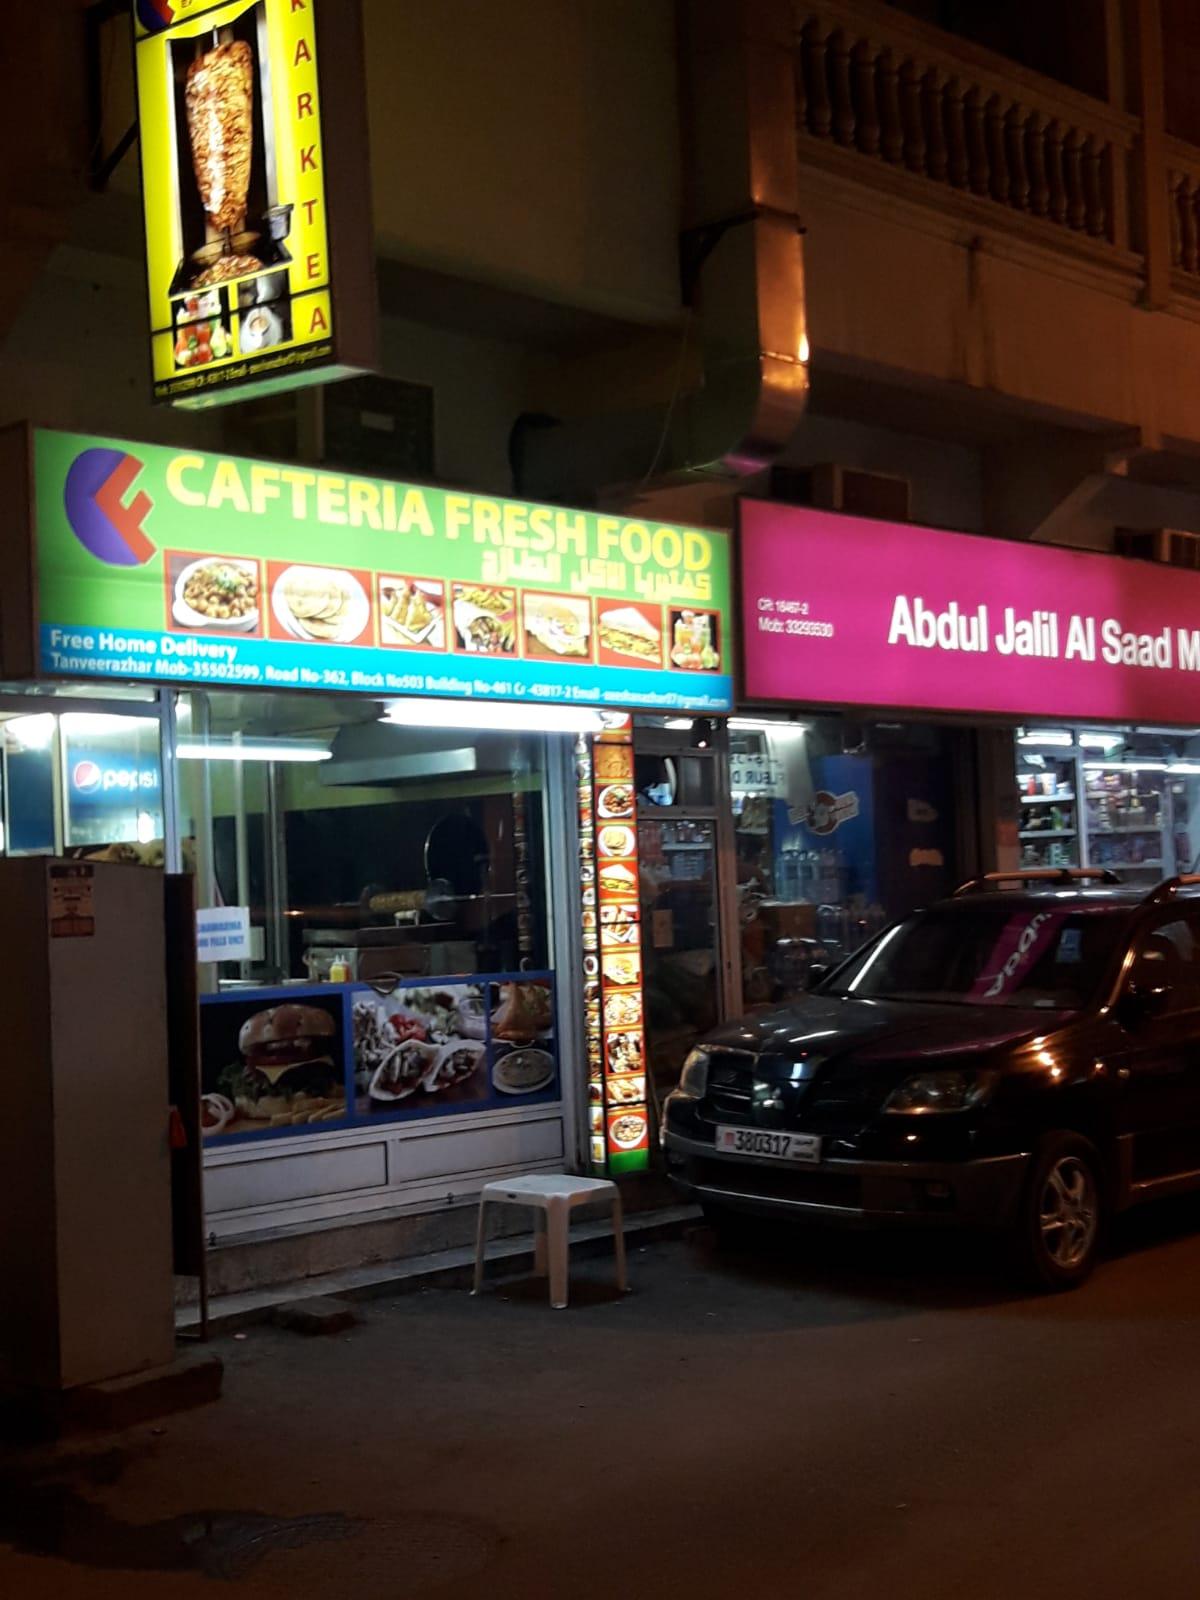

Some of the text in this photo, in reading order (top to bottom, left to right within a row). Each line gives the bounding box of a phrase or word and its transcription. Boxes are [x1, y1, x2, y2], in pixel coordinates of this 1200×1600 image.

[166, 455, 712, 572] CAFTERIA FRESH FOOD
[50, 629, 238, 664] Free Home Delivery
[887, 594, 987, 652] Abdul
[995, 606, 1058, 659] Jalil
[1065, 614, 1096, 662] Al
[1101, 618, 1173, 669] Saad
[51, 652, 153, 674] Tanveerazhar
[264, 665, 300, 683] Road
[351, 671, 385, 687] Block
[102, 769, 158, 791] pepsi
